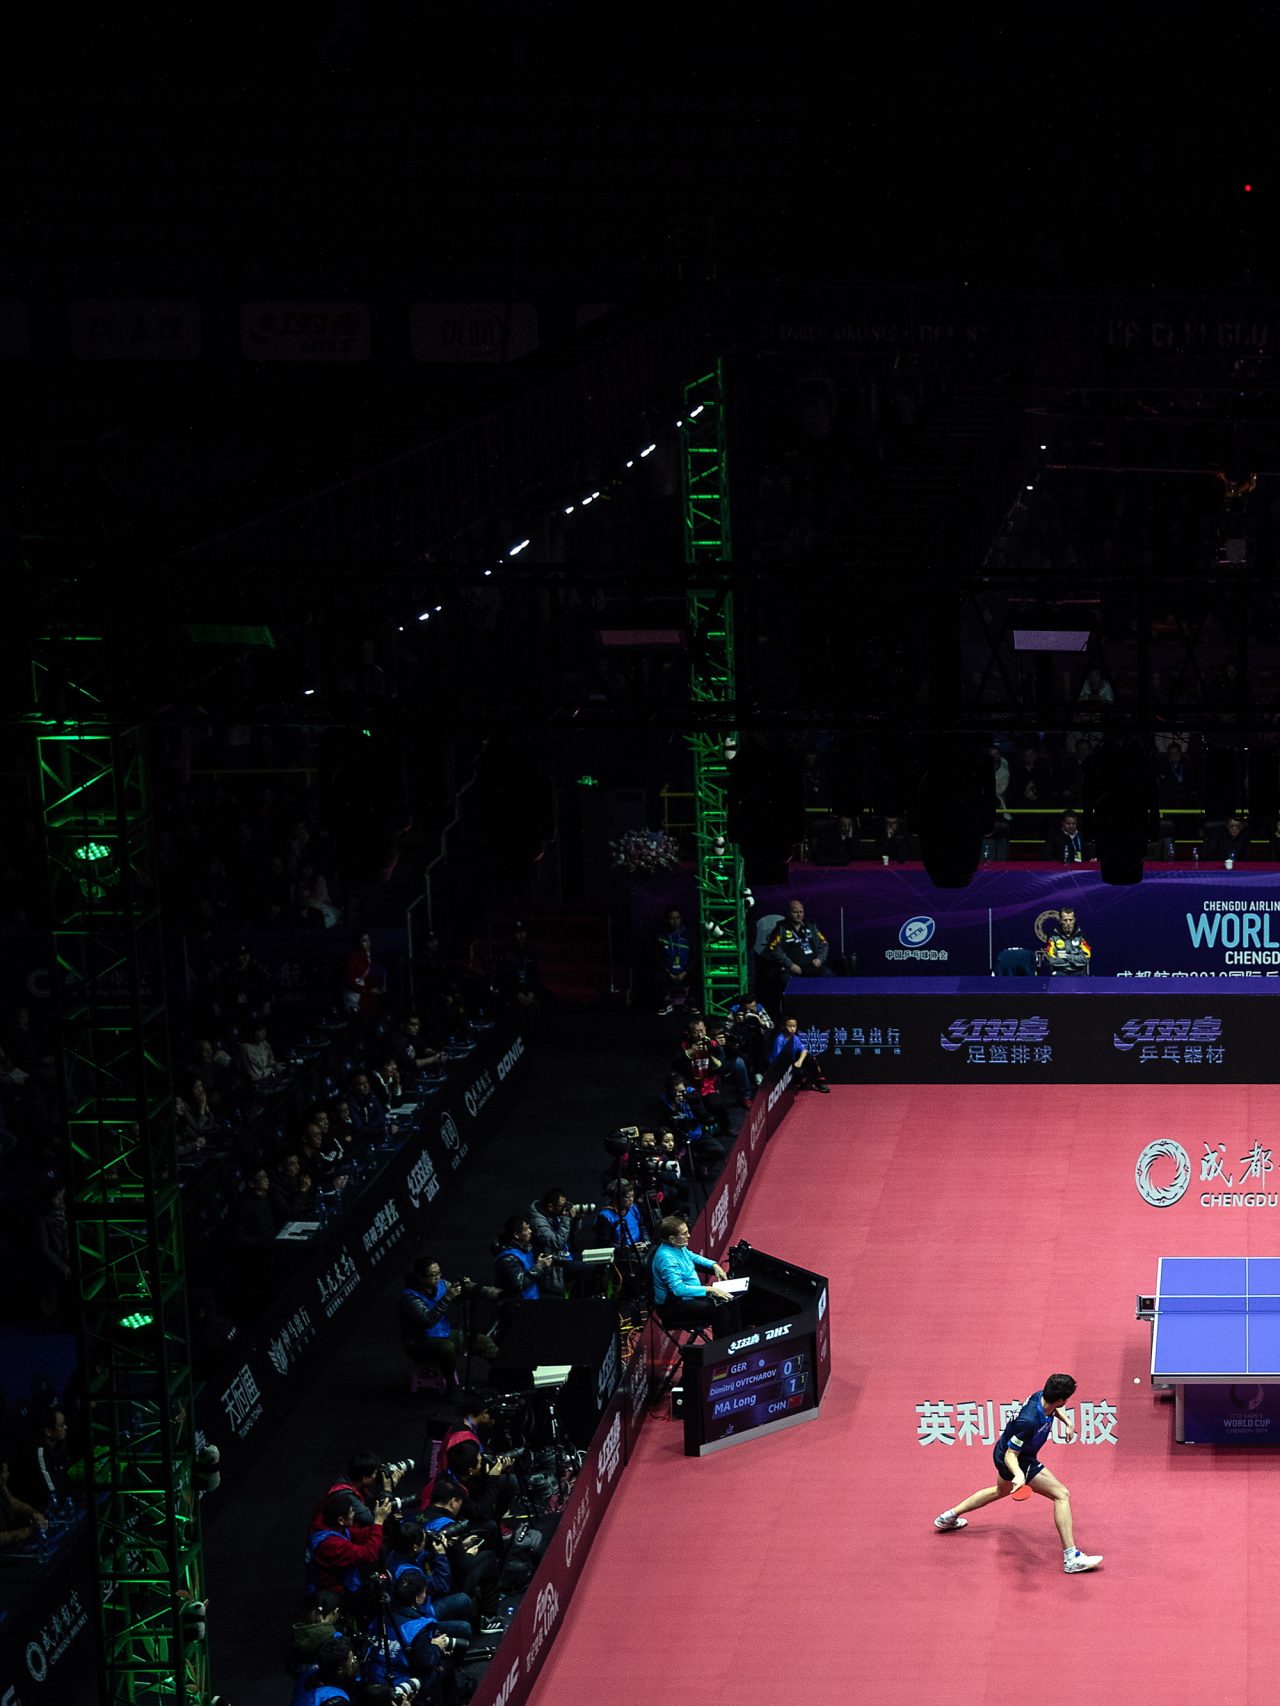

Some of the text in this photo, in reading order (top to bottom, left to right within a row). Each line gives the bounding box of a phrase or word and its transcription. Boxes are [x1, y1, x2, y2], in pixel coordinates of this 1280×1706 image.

[1203, 901, 1247, 912] CHENGDU
[966, 1045, 1053, 1063] 足篮排球
[1139, 1045, 1225, 1063] 乒乓器材
[1200, 1192, 1278, 1207] CHENGDU
[730, 1362, 748, 1374] GER
[710, 1381, 735, 1397] Dimitrij
[735, 1369, 777, 1388] OVTCHAROV
[783, 1361, 793, 1375] 0
[714, 1400, 731, 1415] MA
[733, 1395, 757, 1410] Long
[768, 1400, 787, 1413] CHN
[1223, 1419, 1271, 1427] WORLD CUP
